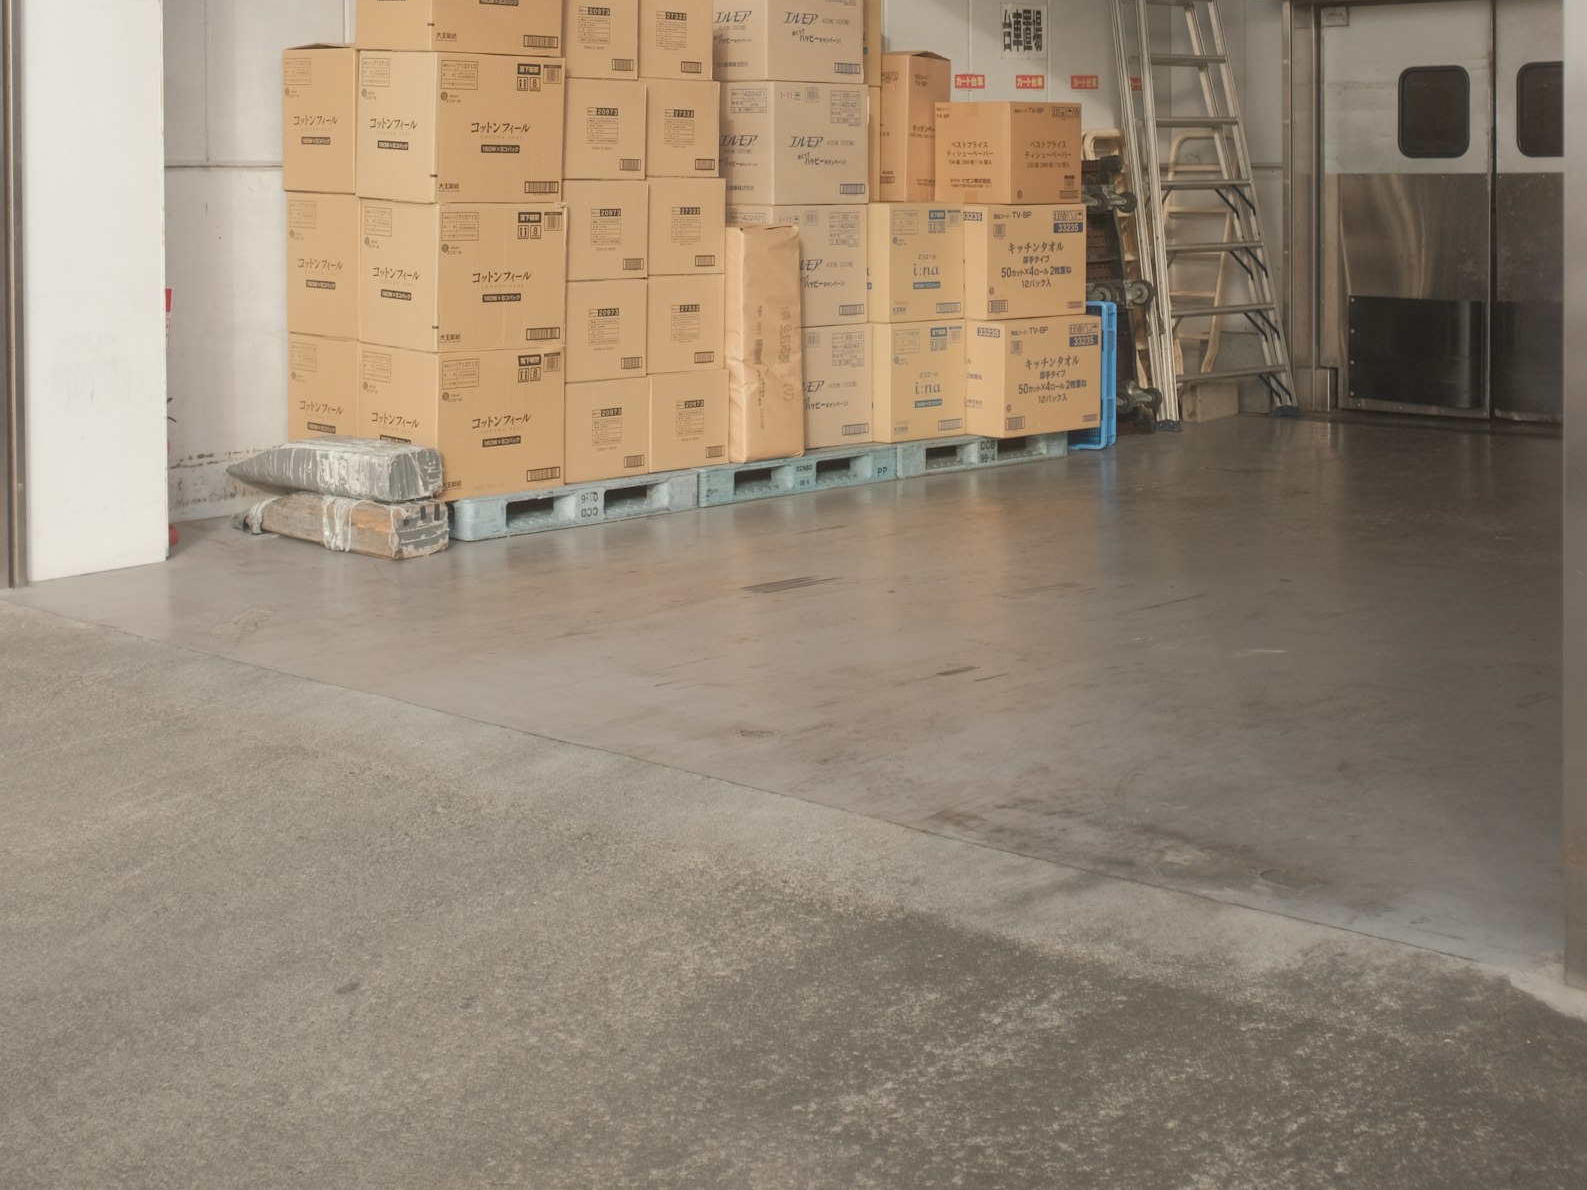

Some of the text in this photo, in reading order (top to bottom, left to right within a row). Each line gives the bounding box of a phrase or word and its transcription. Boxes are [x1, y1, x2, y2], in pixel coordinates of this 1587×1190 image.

[588, 7, 610, 16] 20973
[712, 10, 752, 24] エルモア
[783, 11, 819, 26] エルモア
[1002, 9, 1043, 52] 台車置場
[597, 108, 618, 117] 20973
[293, 114, 338, 126] コットンフィール
[369, 117, 418, 130] コットンフィール
[470, 121, 531, 134] コットンフィール
[720, 134, 758, 147] エルモア
[788, 136, 824, 149] エルモア
[1030, 141, 1067, 149] ベストプライス
[1024, 150, 1072, 160] ティシューペーパー
[600, 209, 621, 217] 20973
[1012, 211, 1032, 219] TV-BP
[1058, 223, 1079, 232] 33235
[1008, 241, 1064, 254] キッチンタオル
[297, 257, 344, 271] コットンフィール
[1022, 255, 1050, 264] 厚手タイプ
[372, 267, 421, 281] コットンフィール
[913, 263, 941, 276] i:na
[1050, 265, 1072, 275] 2枚重ね
[472, 271, 532, 283] コットンフィール
[1022, 279, 1052, 288] 12パック入
[598, 308, 619, 317] 20973
[978, 327, 1000, 338] 33235
[1029, 326, 1049, 335] TV-BP
[1073, 337, 1094, 346] 33235
[1025, 355, 1080, 370] キッチンタオル
[1039, 370, 1066, 379] 厚手タイプ
[915, 381, 942, 395] i:na
[1065, 379, 1087, 390] 2枚重ね
[1038, 393, 1067, 404] 12パック入
[299, 400, 344, 415] コットンフィール
[684, 400, 704, 409] 20973
[601, 408, 622, 417] 20973
[371, 411, 420, 429] コットンフィール
[472, 413, 532, 429] コットンフィール
[877, 466, 888, 478] PP
